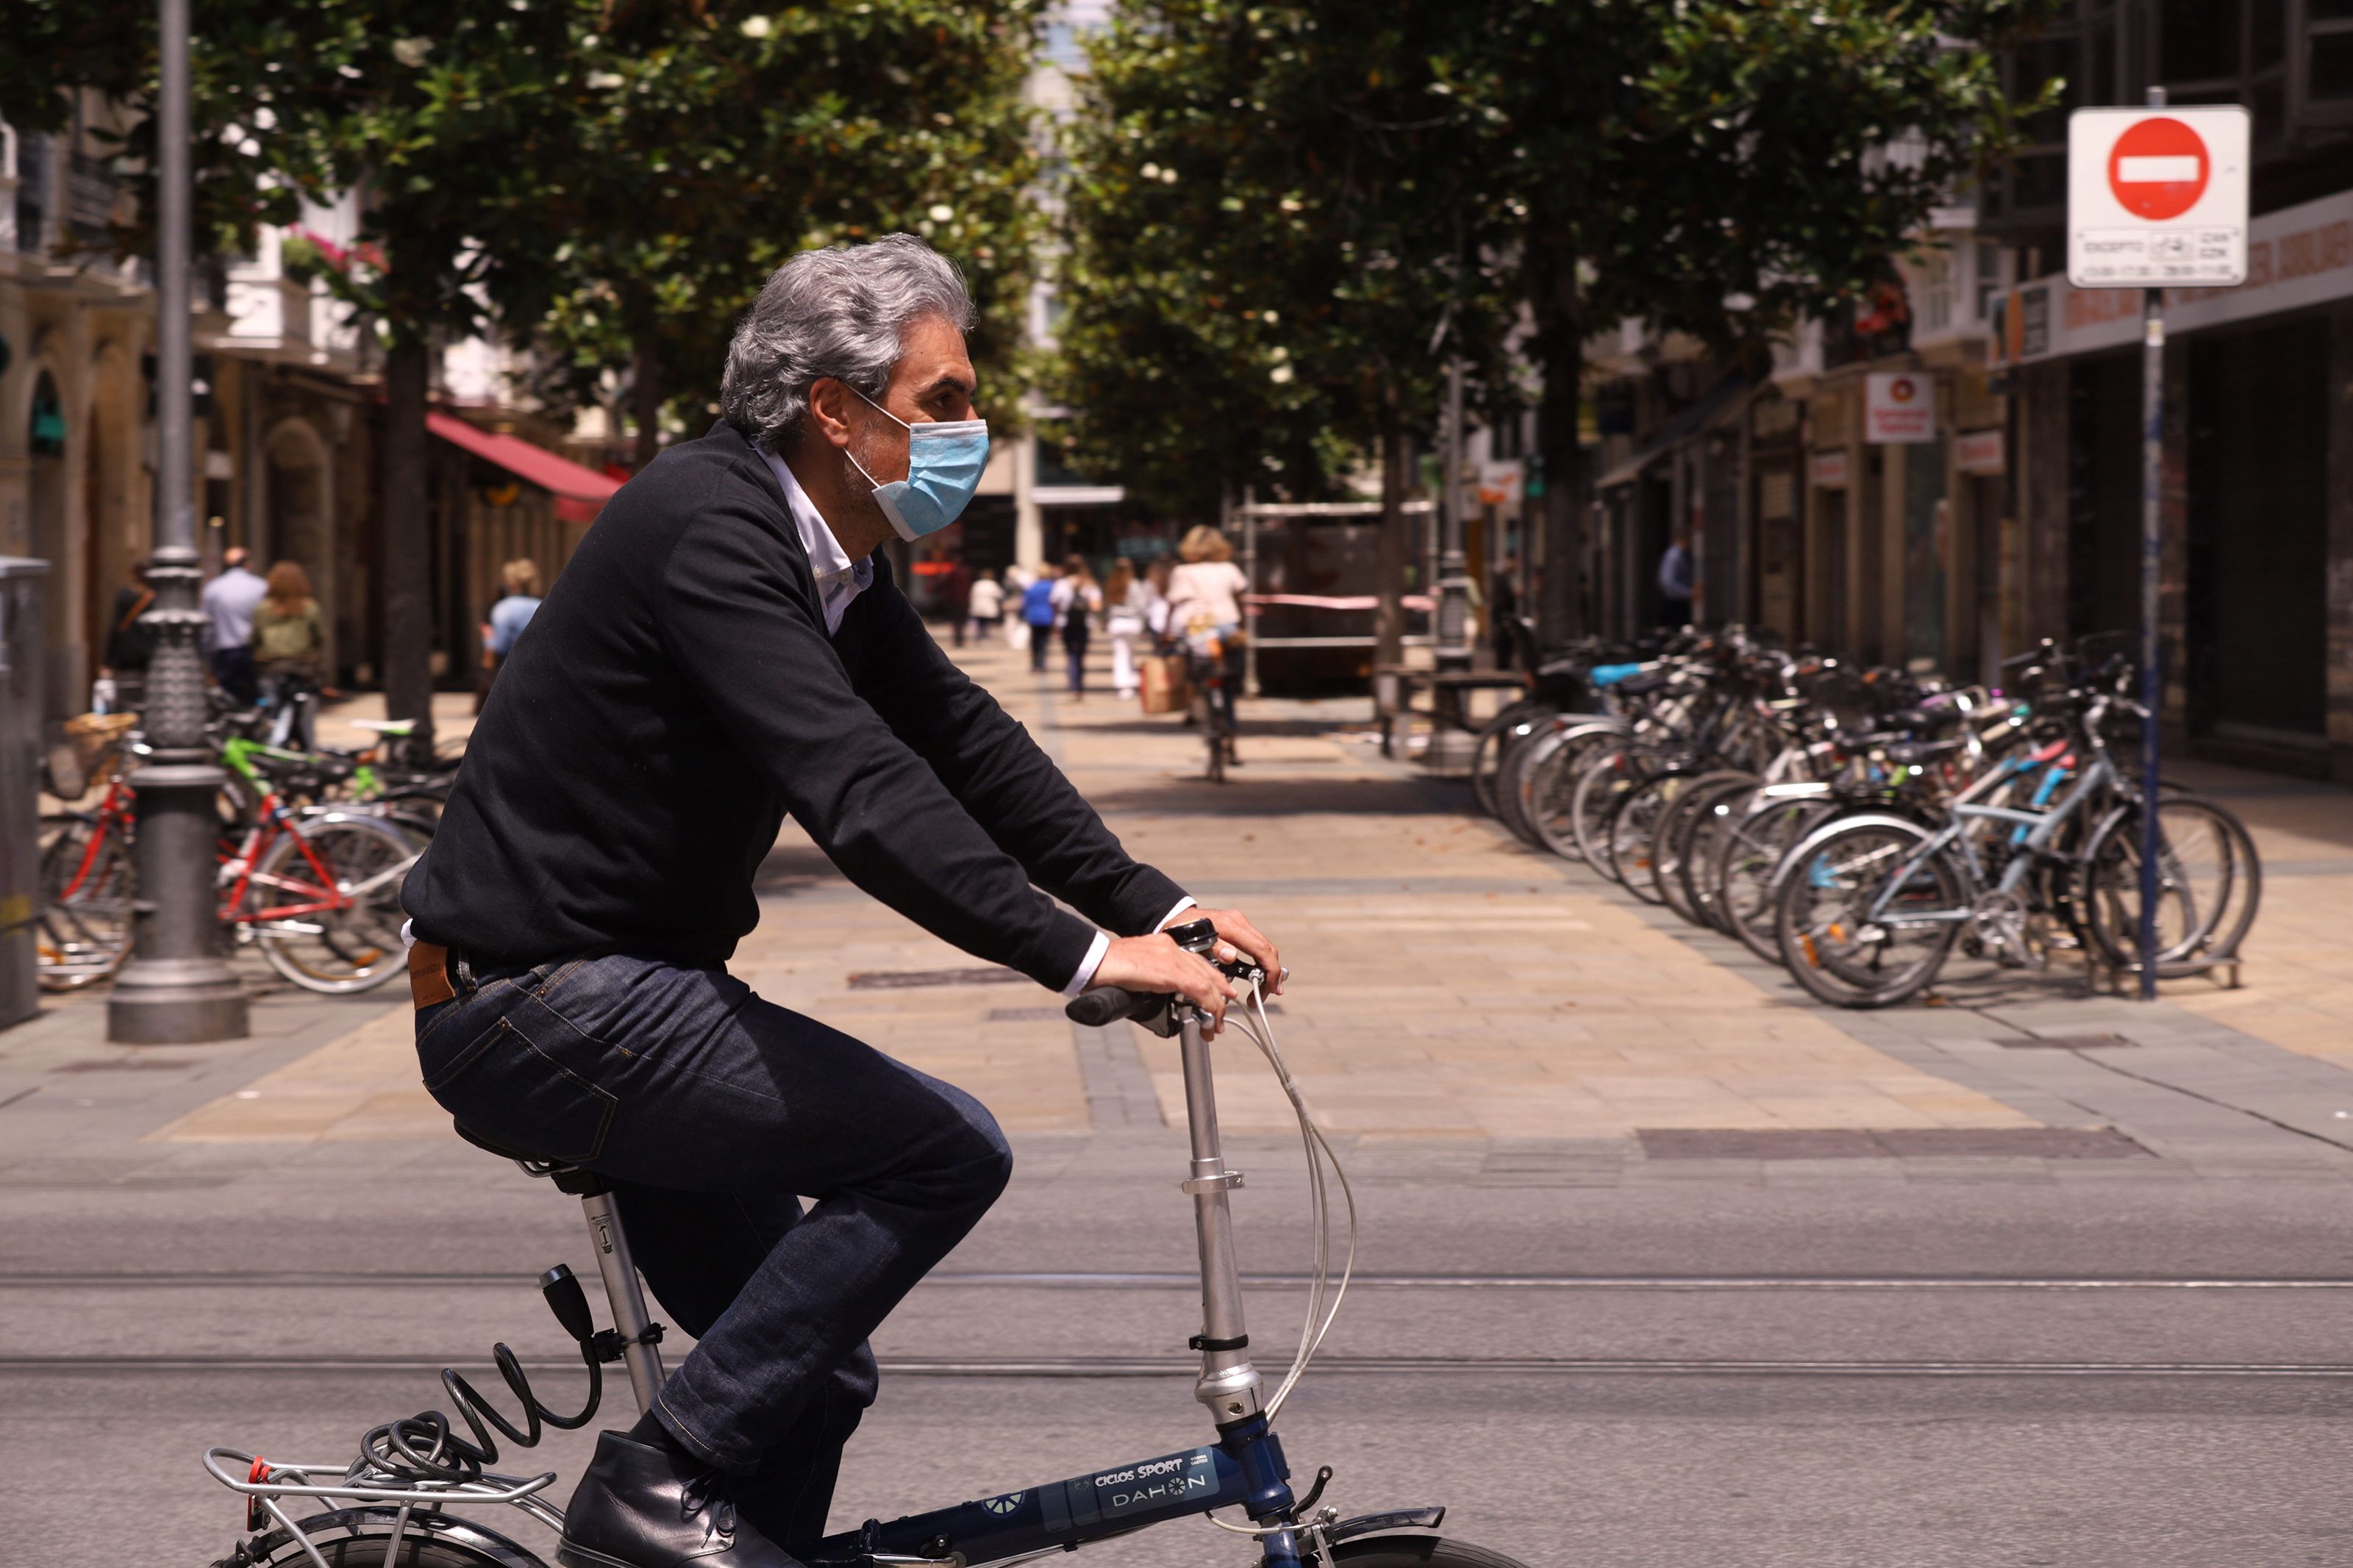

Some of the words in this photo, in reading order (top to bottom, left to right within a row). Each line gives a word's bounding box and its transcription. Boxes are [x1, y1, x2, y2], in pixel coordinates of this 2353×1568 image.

[2084, 240, 2145, 254] EXCEPTO
[1095, 1470, 1135, 1487] CICLOS
[1137, 1458, 1183, 1479] SPORT
[1113, 1475, 1206, 1507] DAHON
